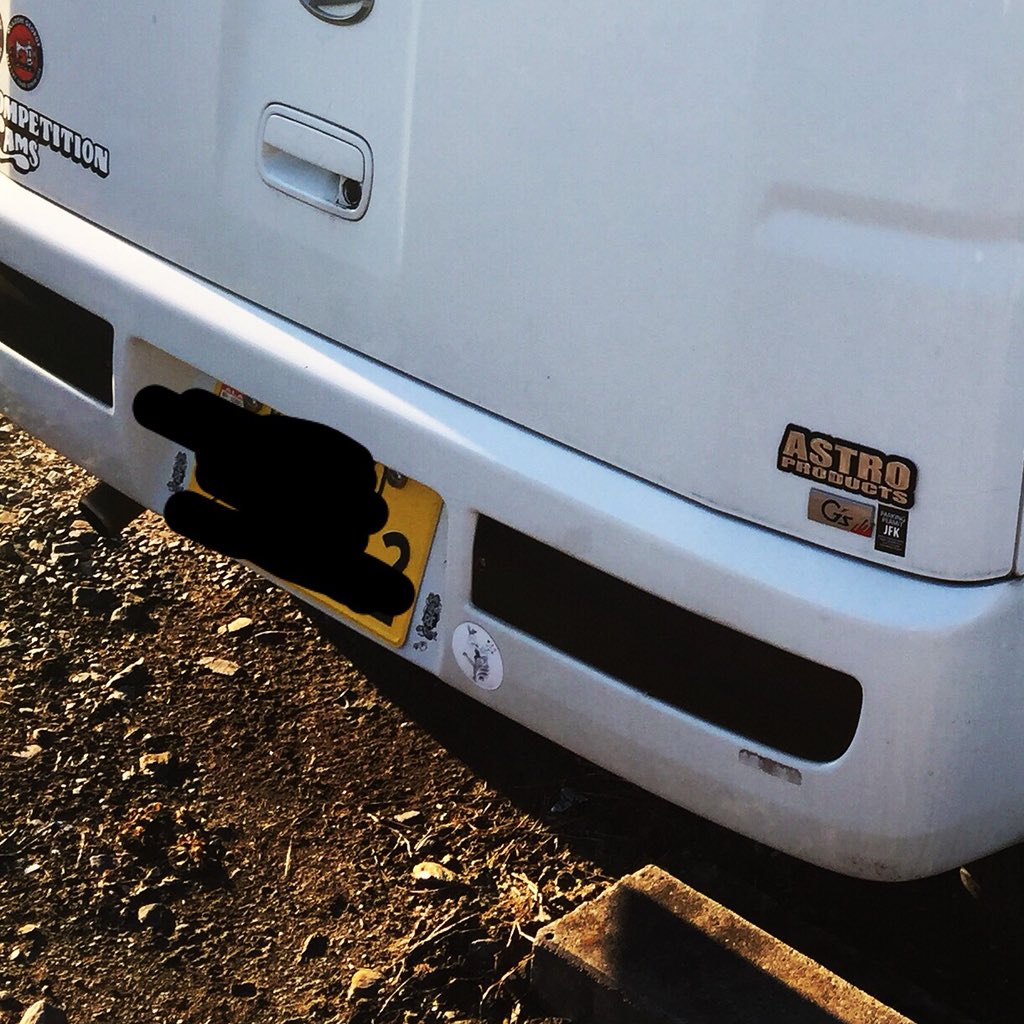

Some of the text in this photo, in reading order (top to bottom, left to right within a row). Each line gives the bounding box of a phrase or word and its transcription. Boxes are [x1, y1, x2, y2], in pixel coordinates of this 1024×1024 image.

[0, 90, 109, 174] MPETITION
[781, 456, 909, 506] PRODUCTS
[782, 430, 911, 491] ASTRO
[883, 525, 900, 538] JFK
